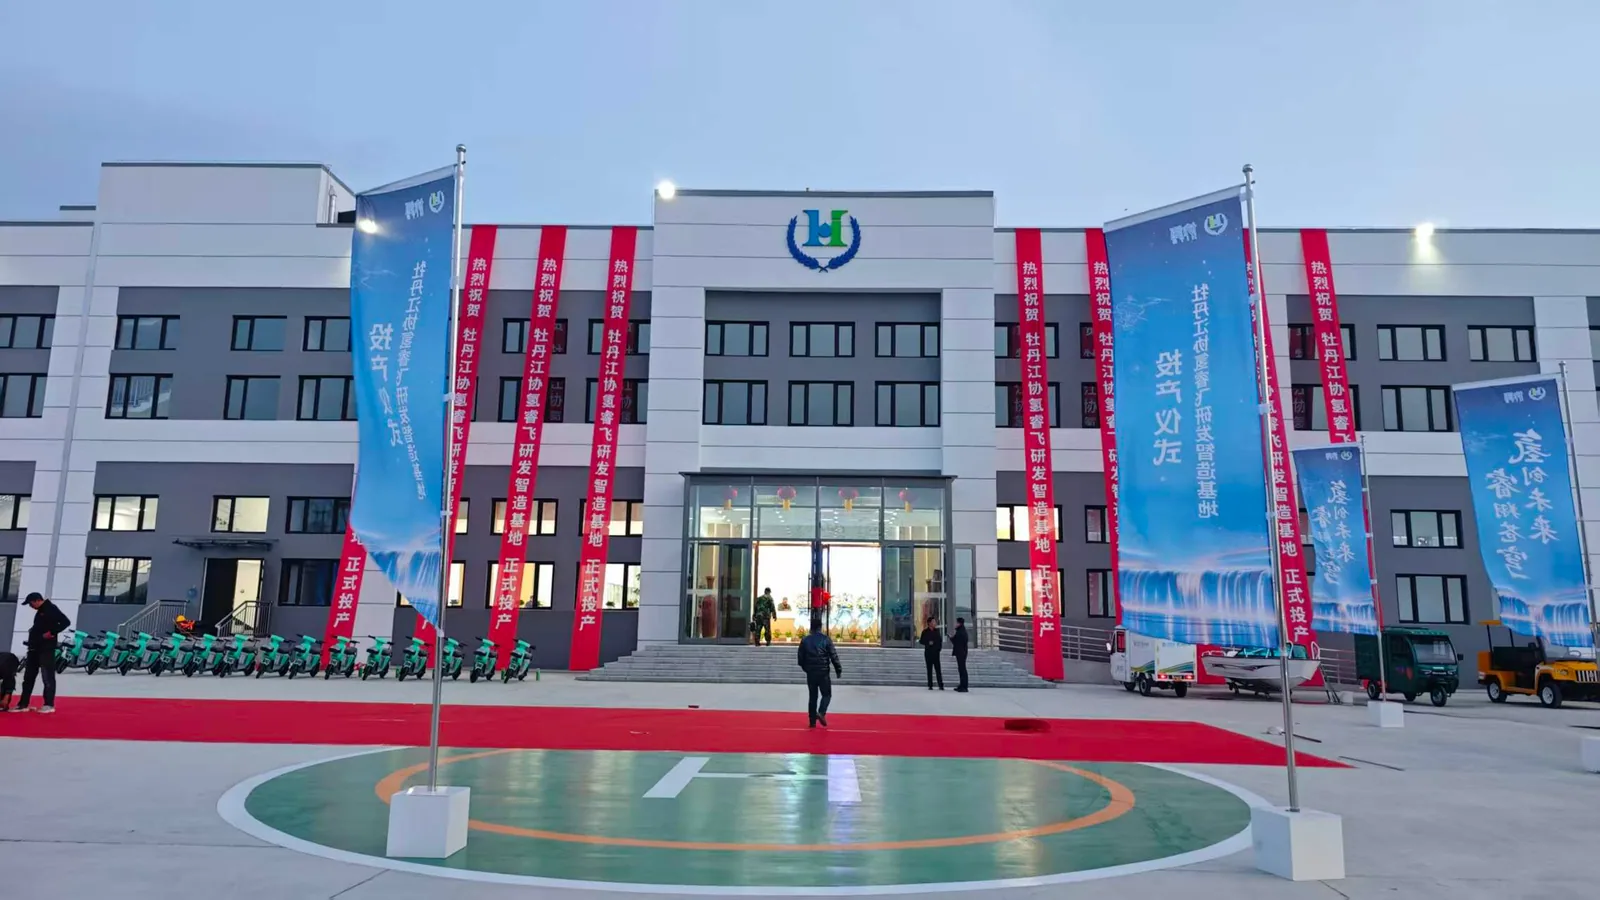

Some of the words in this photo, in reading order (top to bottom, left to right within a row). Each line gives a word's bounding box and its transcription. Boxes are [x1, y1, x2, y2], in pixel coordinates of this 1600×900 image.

[467, 257, 487, 317] 热烈祝贺
[536, 257, 558, 318] 热烈祝贺
[609, 259, 629, 319] 热烈祝贺
[1022, 261, 1039, 322] 热烈祝贺
[1093, 261, 1112, 321] 热烈祝贺
[1311, 261, 1334, 321] 热烈祝贺
[507, 328, 549, 546] 牡丹江协氢睿飞研发智造基地
[588, 329, 622, 547] 牡丹江协氢睿飞研发智造基地
[1025, 332, 1051, 553] 牡丹江协氢睿飞研发智造基地
[333, 556, 361, 628] 正式投产
[495, 556, 520, 630] 正式投产
[579, 558, 601, 631] 正式投产
[1035, 564, 1056, 638] 正式投产
[1284, 568, 1309, 642] 正式投产
